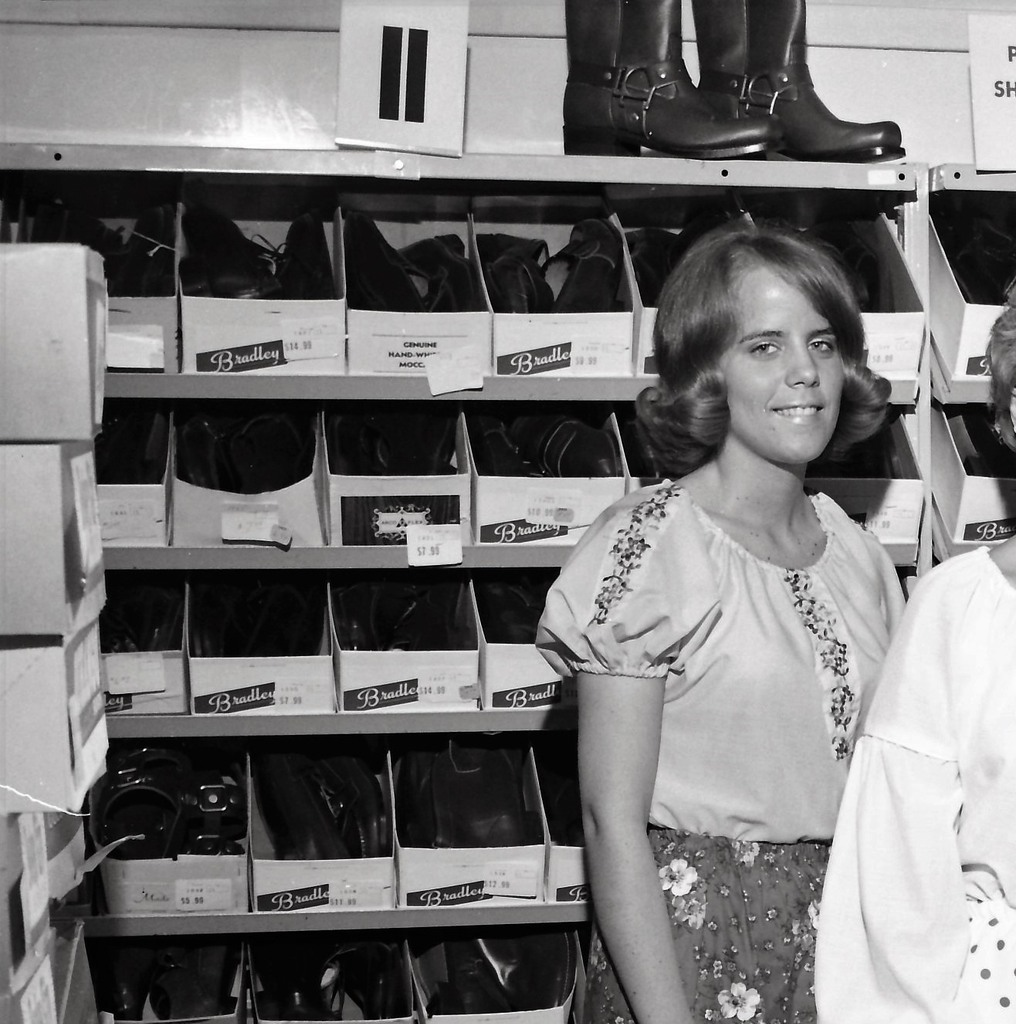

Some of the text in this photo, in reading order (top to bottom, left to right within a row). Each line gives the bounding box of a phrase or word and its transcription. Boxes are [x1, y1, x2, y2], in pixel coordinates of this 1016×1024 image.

[379, 26, 430, 123] 11
[210, 345, 281, 373] Bradley
[403, 341, 438, 349] GENUINE
[398, 361, 426, 369] MOCC.
[511, 346, 572, 376] Bradle
[357, 681, 420, 710] Bradle
[271, 887, 331, 912] Bradle
